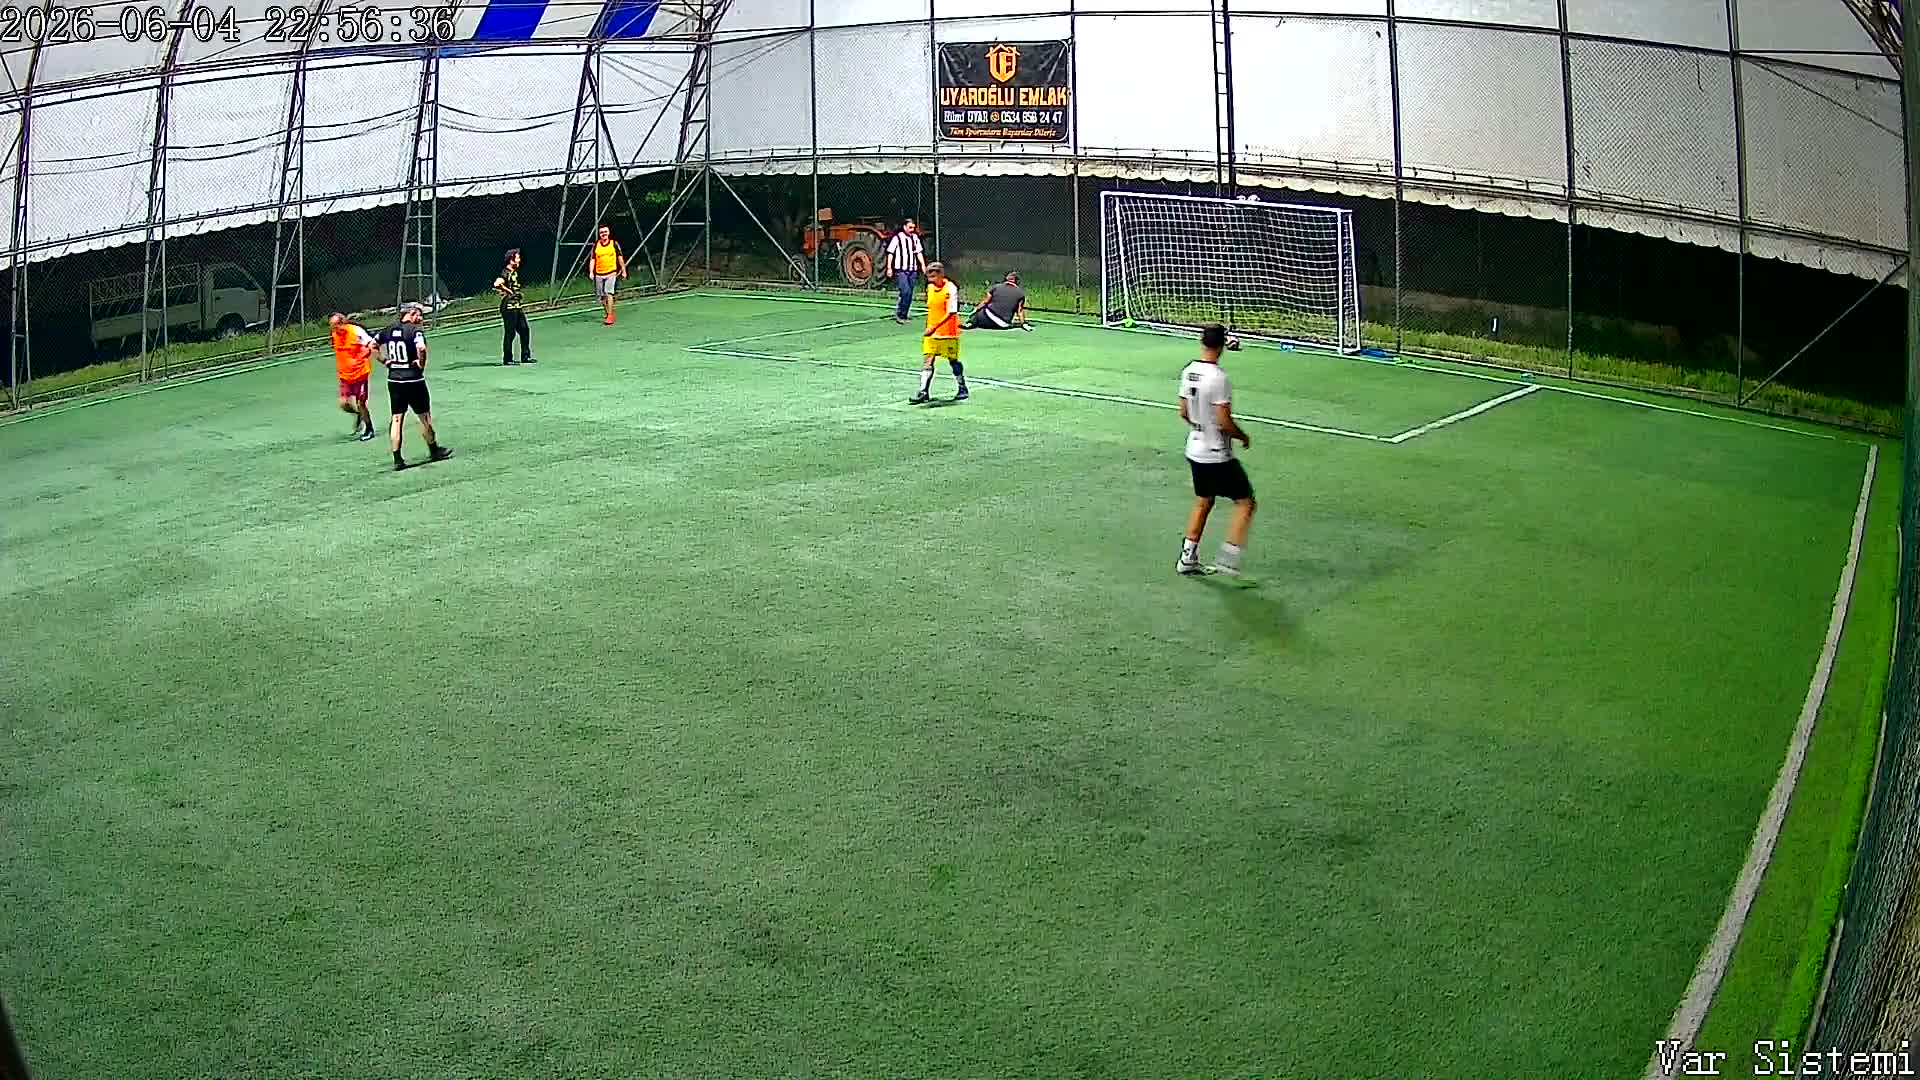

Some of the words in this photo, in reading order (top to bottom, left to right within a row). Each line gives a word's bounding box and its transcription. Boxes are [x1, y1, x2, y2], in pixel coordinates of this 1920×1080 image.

[940, 84, 1014, 106] UYAROĞLU
[1019, 87, 1067, 106] EMLAK
[967, 110, 989, 123] UYAR
[1000, 110, 1021, 123] 0534
[1039, 111, 1051, 123] 24
[1052, 111, 1063, 123] 47
[388, 340, 409, 363] 80
